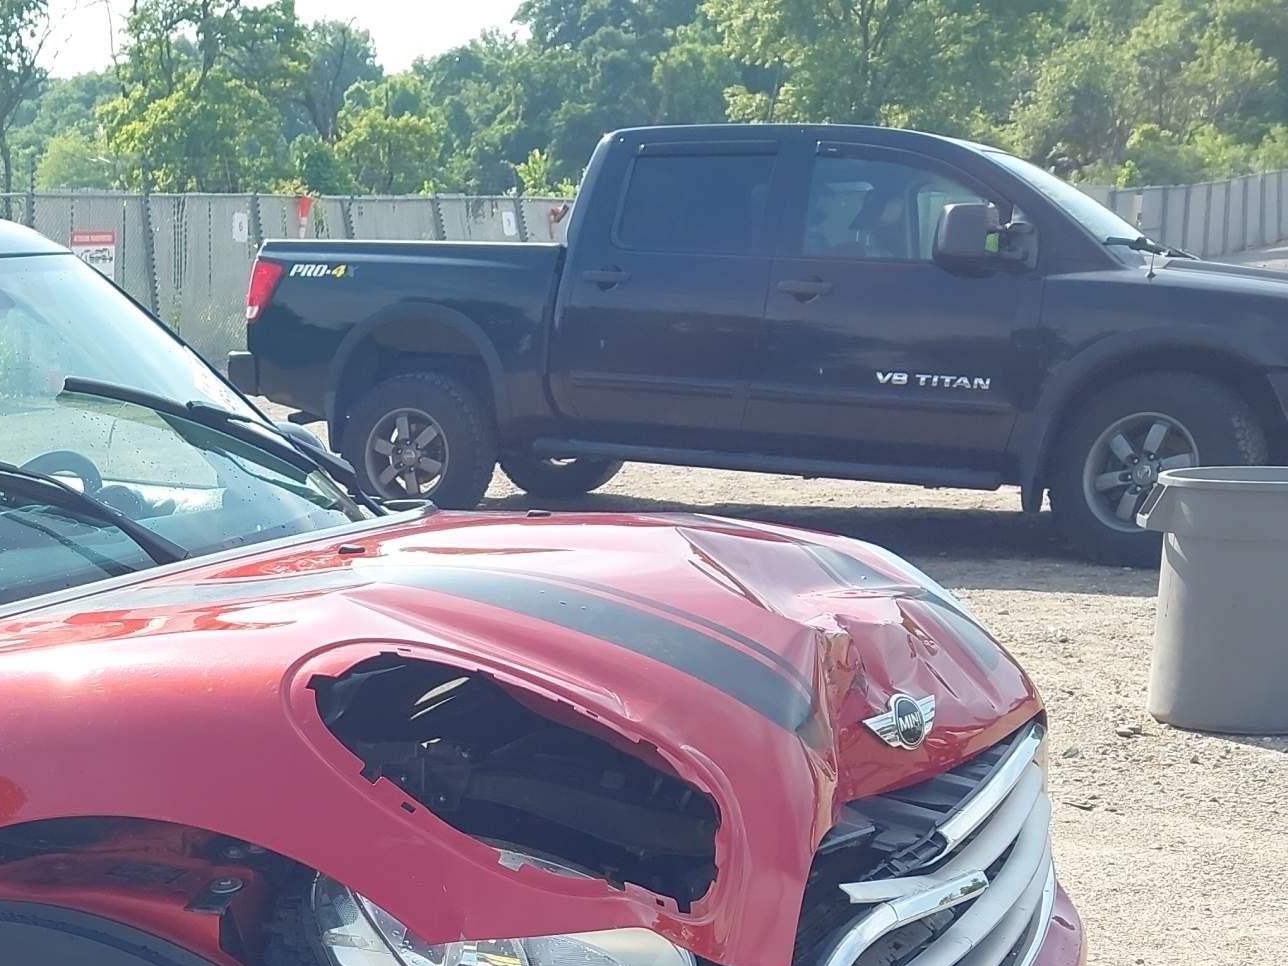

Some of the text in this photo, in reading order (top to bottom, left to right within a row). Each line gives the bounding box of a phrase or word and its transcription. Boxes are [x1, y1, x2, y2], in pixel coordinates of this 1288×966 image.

[876, 371, 991, 390] V8 TITAN
[898, 711, 922, 732] MINI
